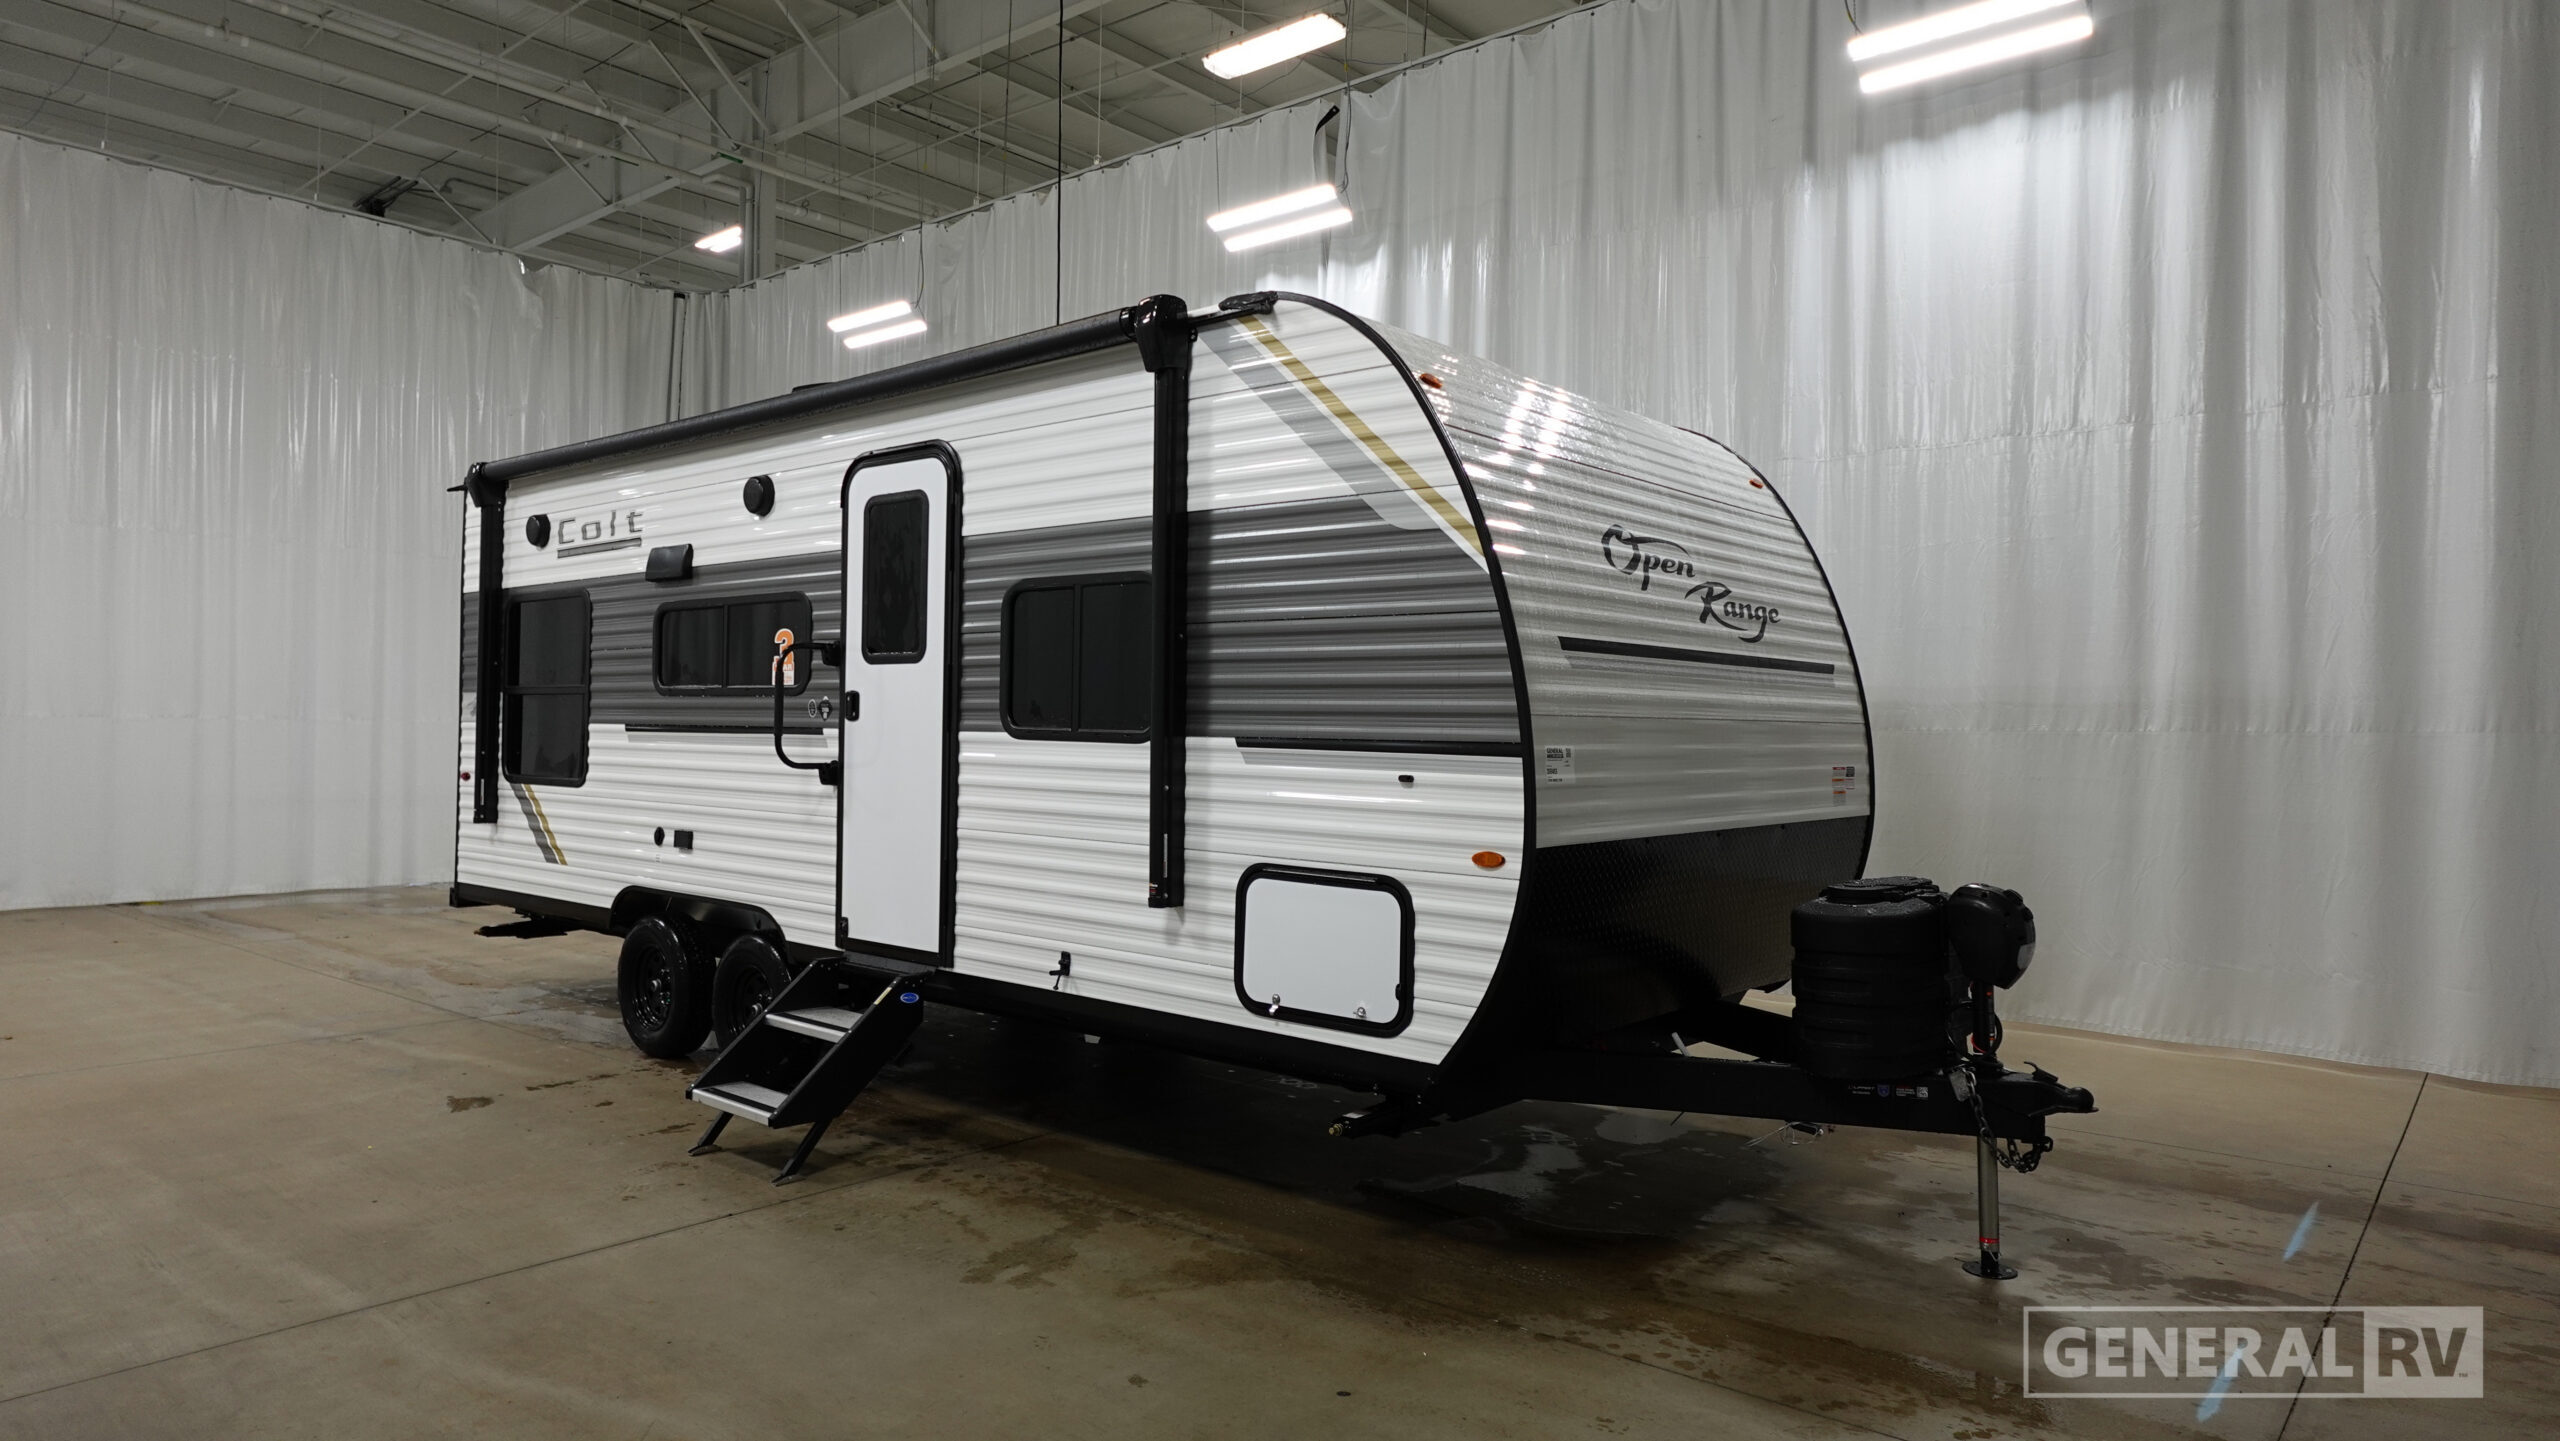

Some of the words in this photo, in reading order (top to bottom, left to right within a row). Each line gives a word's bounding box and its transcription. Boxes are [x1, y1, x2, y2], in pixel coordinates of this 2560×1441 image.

[557, 510, 643, 545] Colt
[1601, 524, 1695, 591] Open
[1684, 581, 1781, 643] Range
